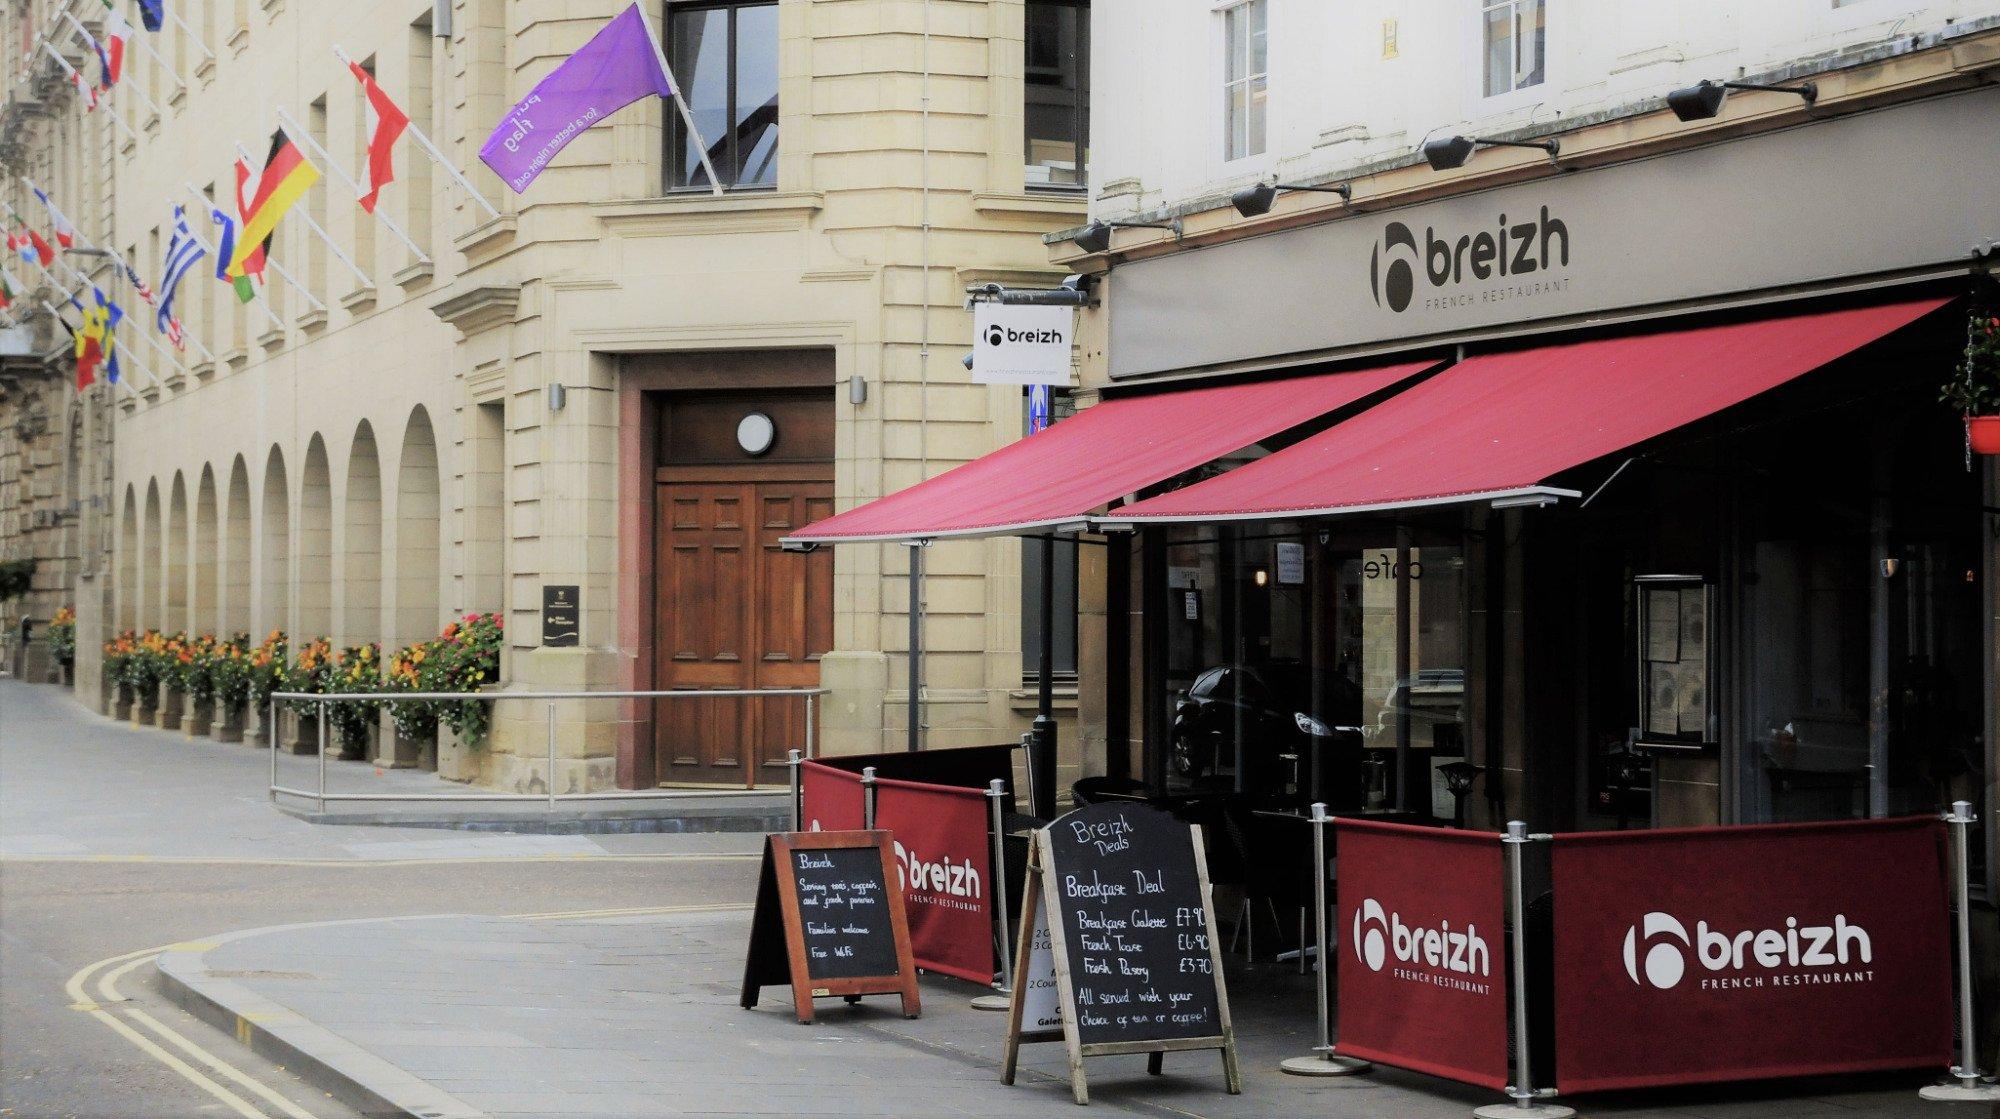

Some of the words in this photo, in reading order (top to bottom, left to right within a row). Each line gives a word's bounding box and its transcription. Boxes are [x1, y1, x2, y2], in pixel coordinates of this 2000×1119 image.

[1426, 205, 1569, 287] breizh
[1425, 296, 1474, 311] FRENCH
[1482, 278, 1571, 303] RESTAURANT
[1007, 328, 1062, 344] breizh
[1070, 813, 1134, 844] Breizh
[1094, 834, 1130, 857] Deals
[798, 853, 835, 869] Breizh
[910, 851, 980, 899] breizh
[1065, 869, 1127, 904] Breakfast
[1132, 869, 1165, 895] Deal
[803, 896, 819, 905] and
[909, 894, 937, 904] FRENCH
[940, 898, 981, 913] RESTAURANT
[807, 921, 837, 934] Families
[842, 923, 870, 934] welcome
[1076, 910, 1127, 935] Breakfast
[1131, 909, 1168, 929] Galette
[811, 947, 829, 958] Free
[1081, 934, 1112, 951] French
[1113, 935, 1143, 953] Toast
[1391, 912, 1489, 977] breizh
[1697, 913, 1872, 971] breizh
[1084, 957, 1112, 975] Fresh
[1394, 968, 1429, 983] FRENCH
[1433, 975, 1490, 995] RESTAURANT
[1701, 977, 1763, 990] FRENCH
[1773, 971, 1874, 986] RESTAURANT
[1079, 987, 1095, 1006] All
[1100, 988, 1131, 1004] served
[1139, 987, 1162, 1003] with
[1169, 991, 1194, 1009] your
[1081, 1009, 1110, 1026] choice
[1132, 1014, 1148, 1023] tea
[1155, 1013, 1166, 1022] or
